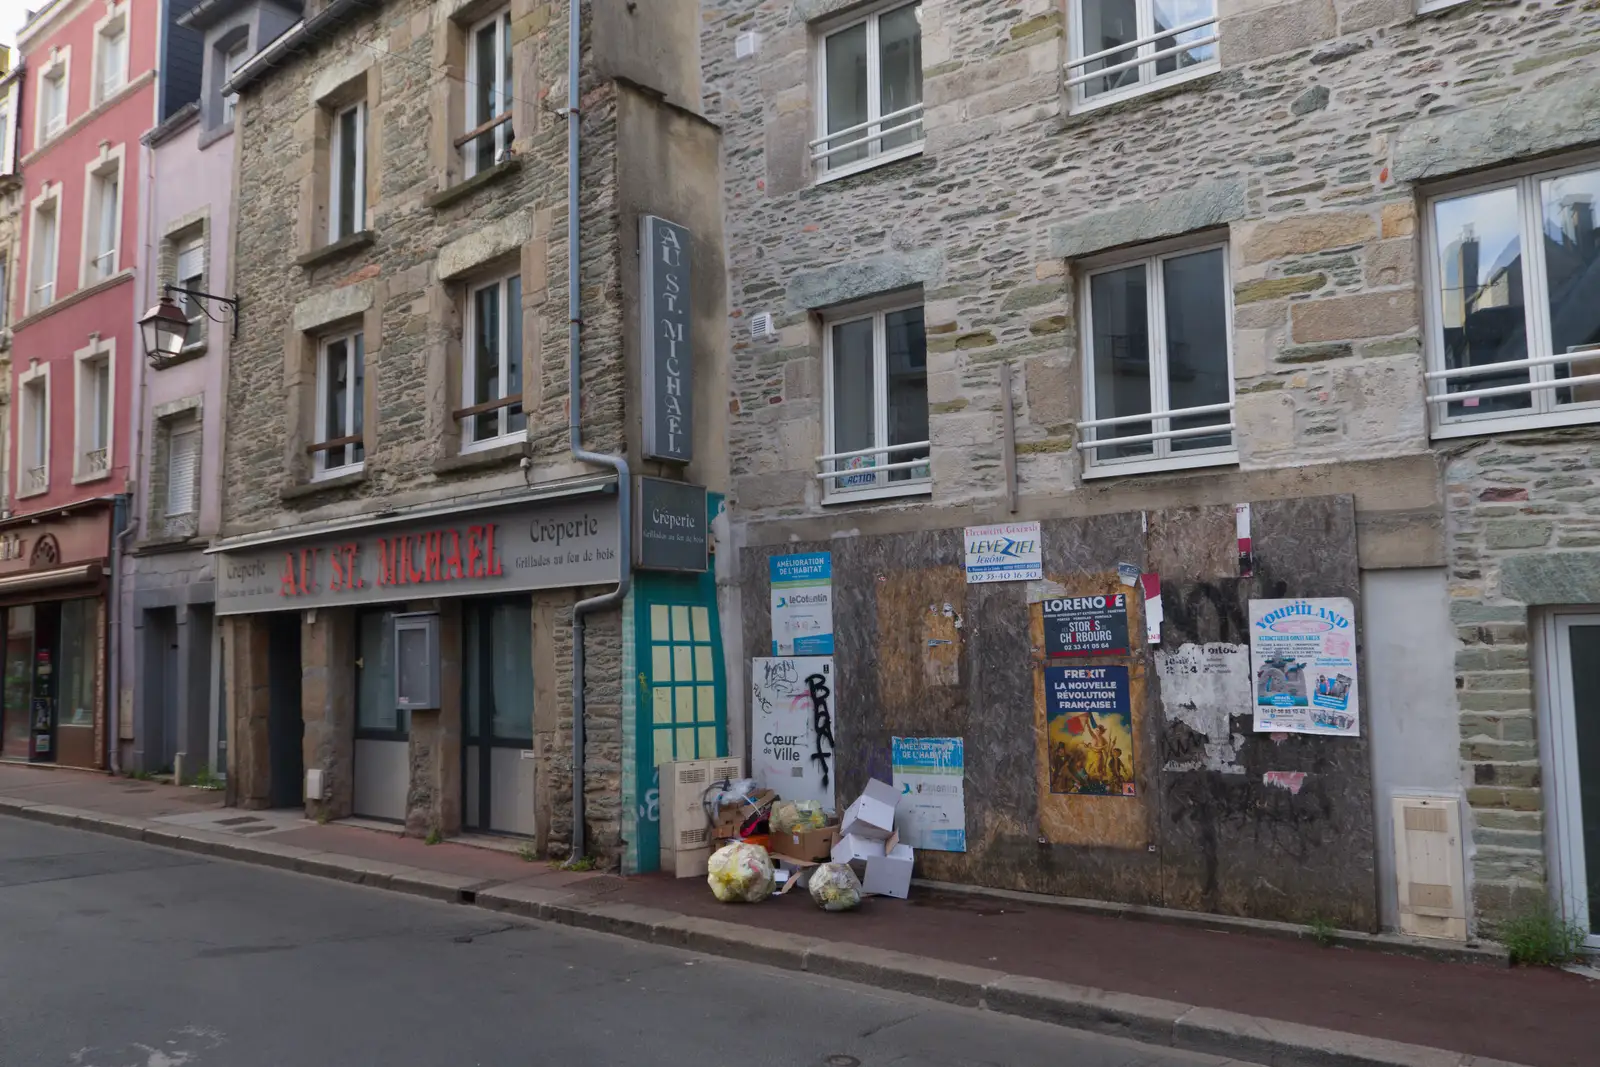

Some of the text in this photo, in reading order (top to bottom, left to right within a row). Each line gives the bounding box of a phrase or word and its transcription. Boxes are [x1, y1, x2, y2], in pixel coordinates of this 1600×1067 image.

[659, 227, 684, 453] AU ST. MICHAEL
[652, 508, 695, 529] Crêperie
[529, 513, 598, 546] Crêperie
[970, 536, 1037, 558] LEVEZIEL
[279, 522, 504, 597] AU ST. MICHAEL
[515, 547, 615, 568] Grillades au feu de bois
[777, 557, 825, 568] AMÉLIORATION
[1044, 594, 1124, 612] LORENOVE
[1060, 630, 1112, 643] CHERBOURG
[1064, 669, 1106, 679] FREXIT
[1054, 681, 1117, 690] LA NOUVELLE
[1056, 690, 1115, 699] RÉVOLUTION
[1059, 701, 1111, 710] FRANÇAISE
[764, 732, 798, 746] Cœur
[763, 747, 800, 761] de Ville
